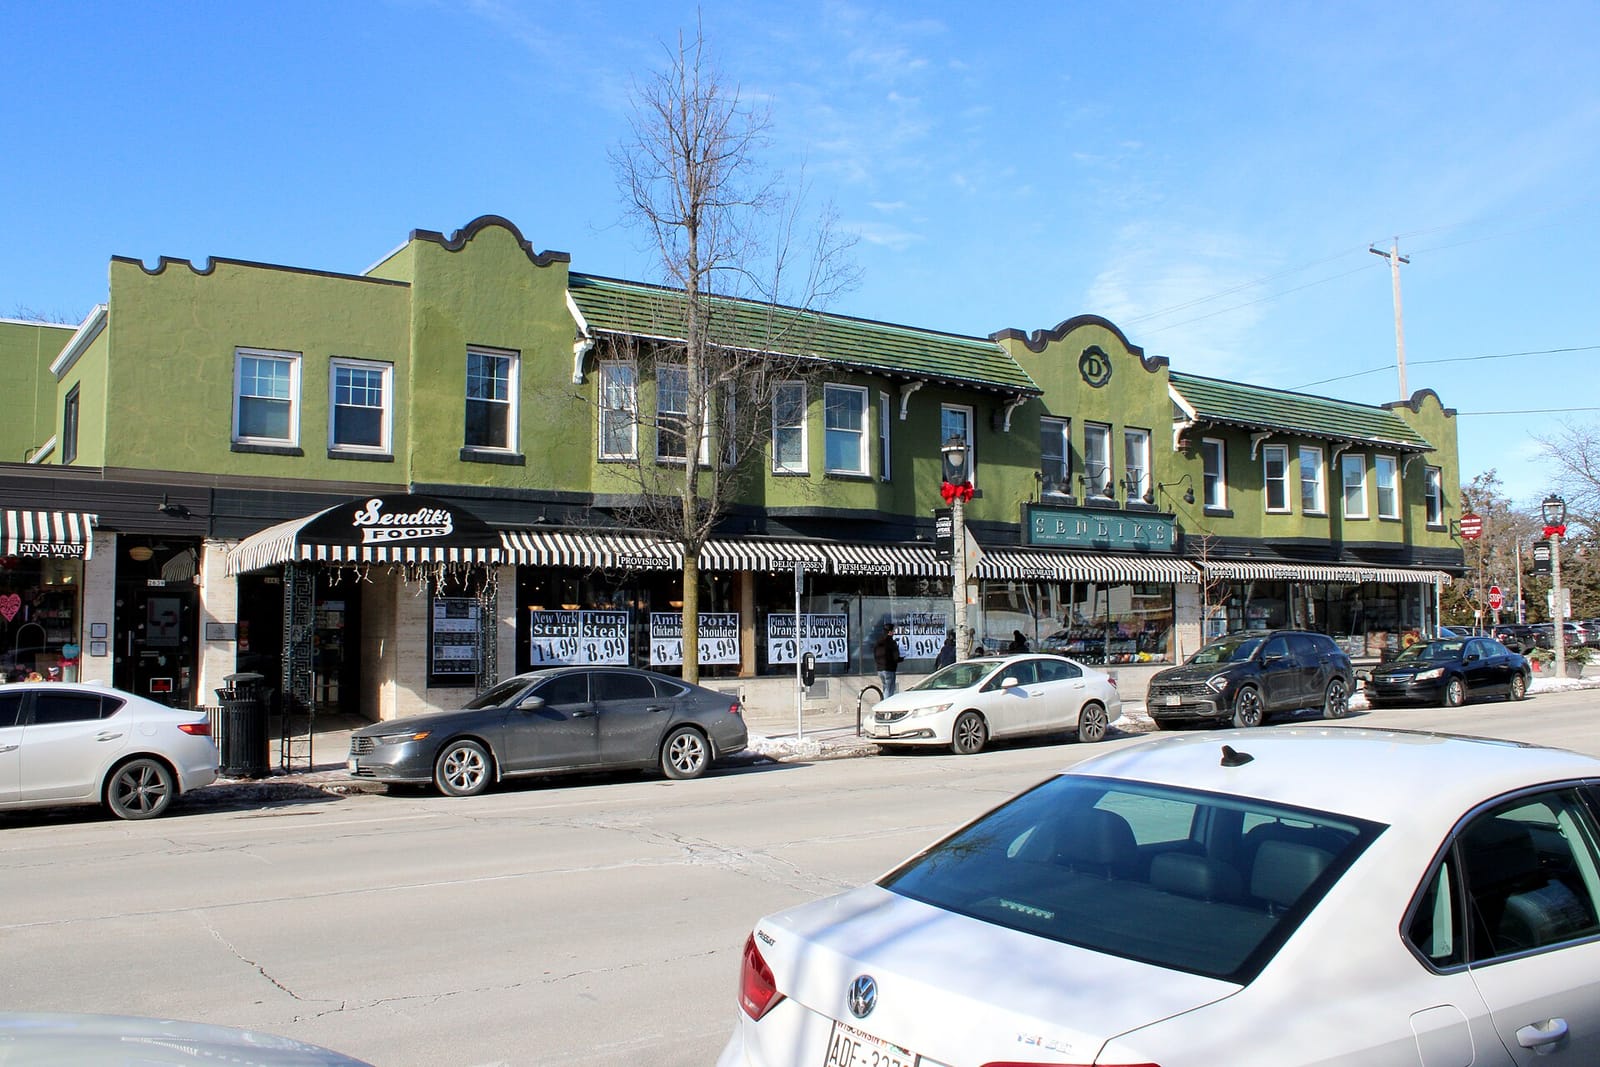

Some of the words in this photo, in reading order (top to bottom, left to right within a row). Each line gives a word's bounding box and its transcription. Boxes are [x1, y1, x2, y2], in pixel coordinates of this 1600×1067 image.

[352, 498, 453, 527] Sendik's
[1035, 516, 1165, 540] SENDIK'S
[373, 529, 446, 539] FOODS
[20, 543, 49, 552] FINE
[50, 544, 84, 554] WINE
[620, 557, 669, 566] PROVISIONS
[772, 560, 824, 570] DELICESSEN
[838, 563, 859, 571] FRESH
[860, 564, 891, 572] SEAFOOD
[1489, 593, 1501, 603] STOP
[534, 612, 554, 624] New
[556, 612, 577, 624] York
[584, 613, 626, 624] Tuna
[653, 615, 683, 625] Amis
[698, 615, 736, 626] Pork
[771, 617, 786, 626] Pink
[788, 616, 807, 626] Nael
[810, 616, 846, 627] Honeycrisp
[534, 624, 578, 637] Strip
[584, 625, 625, 637] Steak
[653, 626, 674, 637] Chicken
[698, 627, 737, 638] Shoulder
[811, 625, 846, 638] Apples
[914, 625, 945, 635] Potatoes
